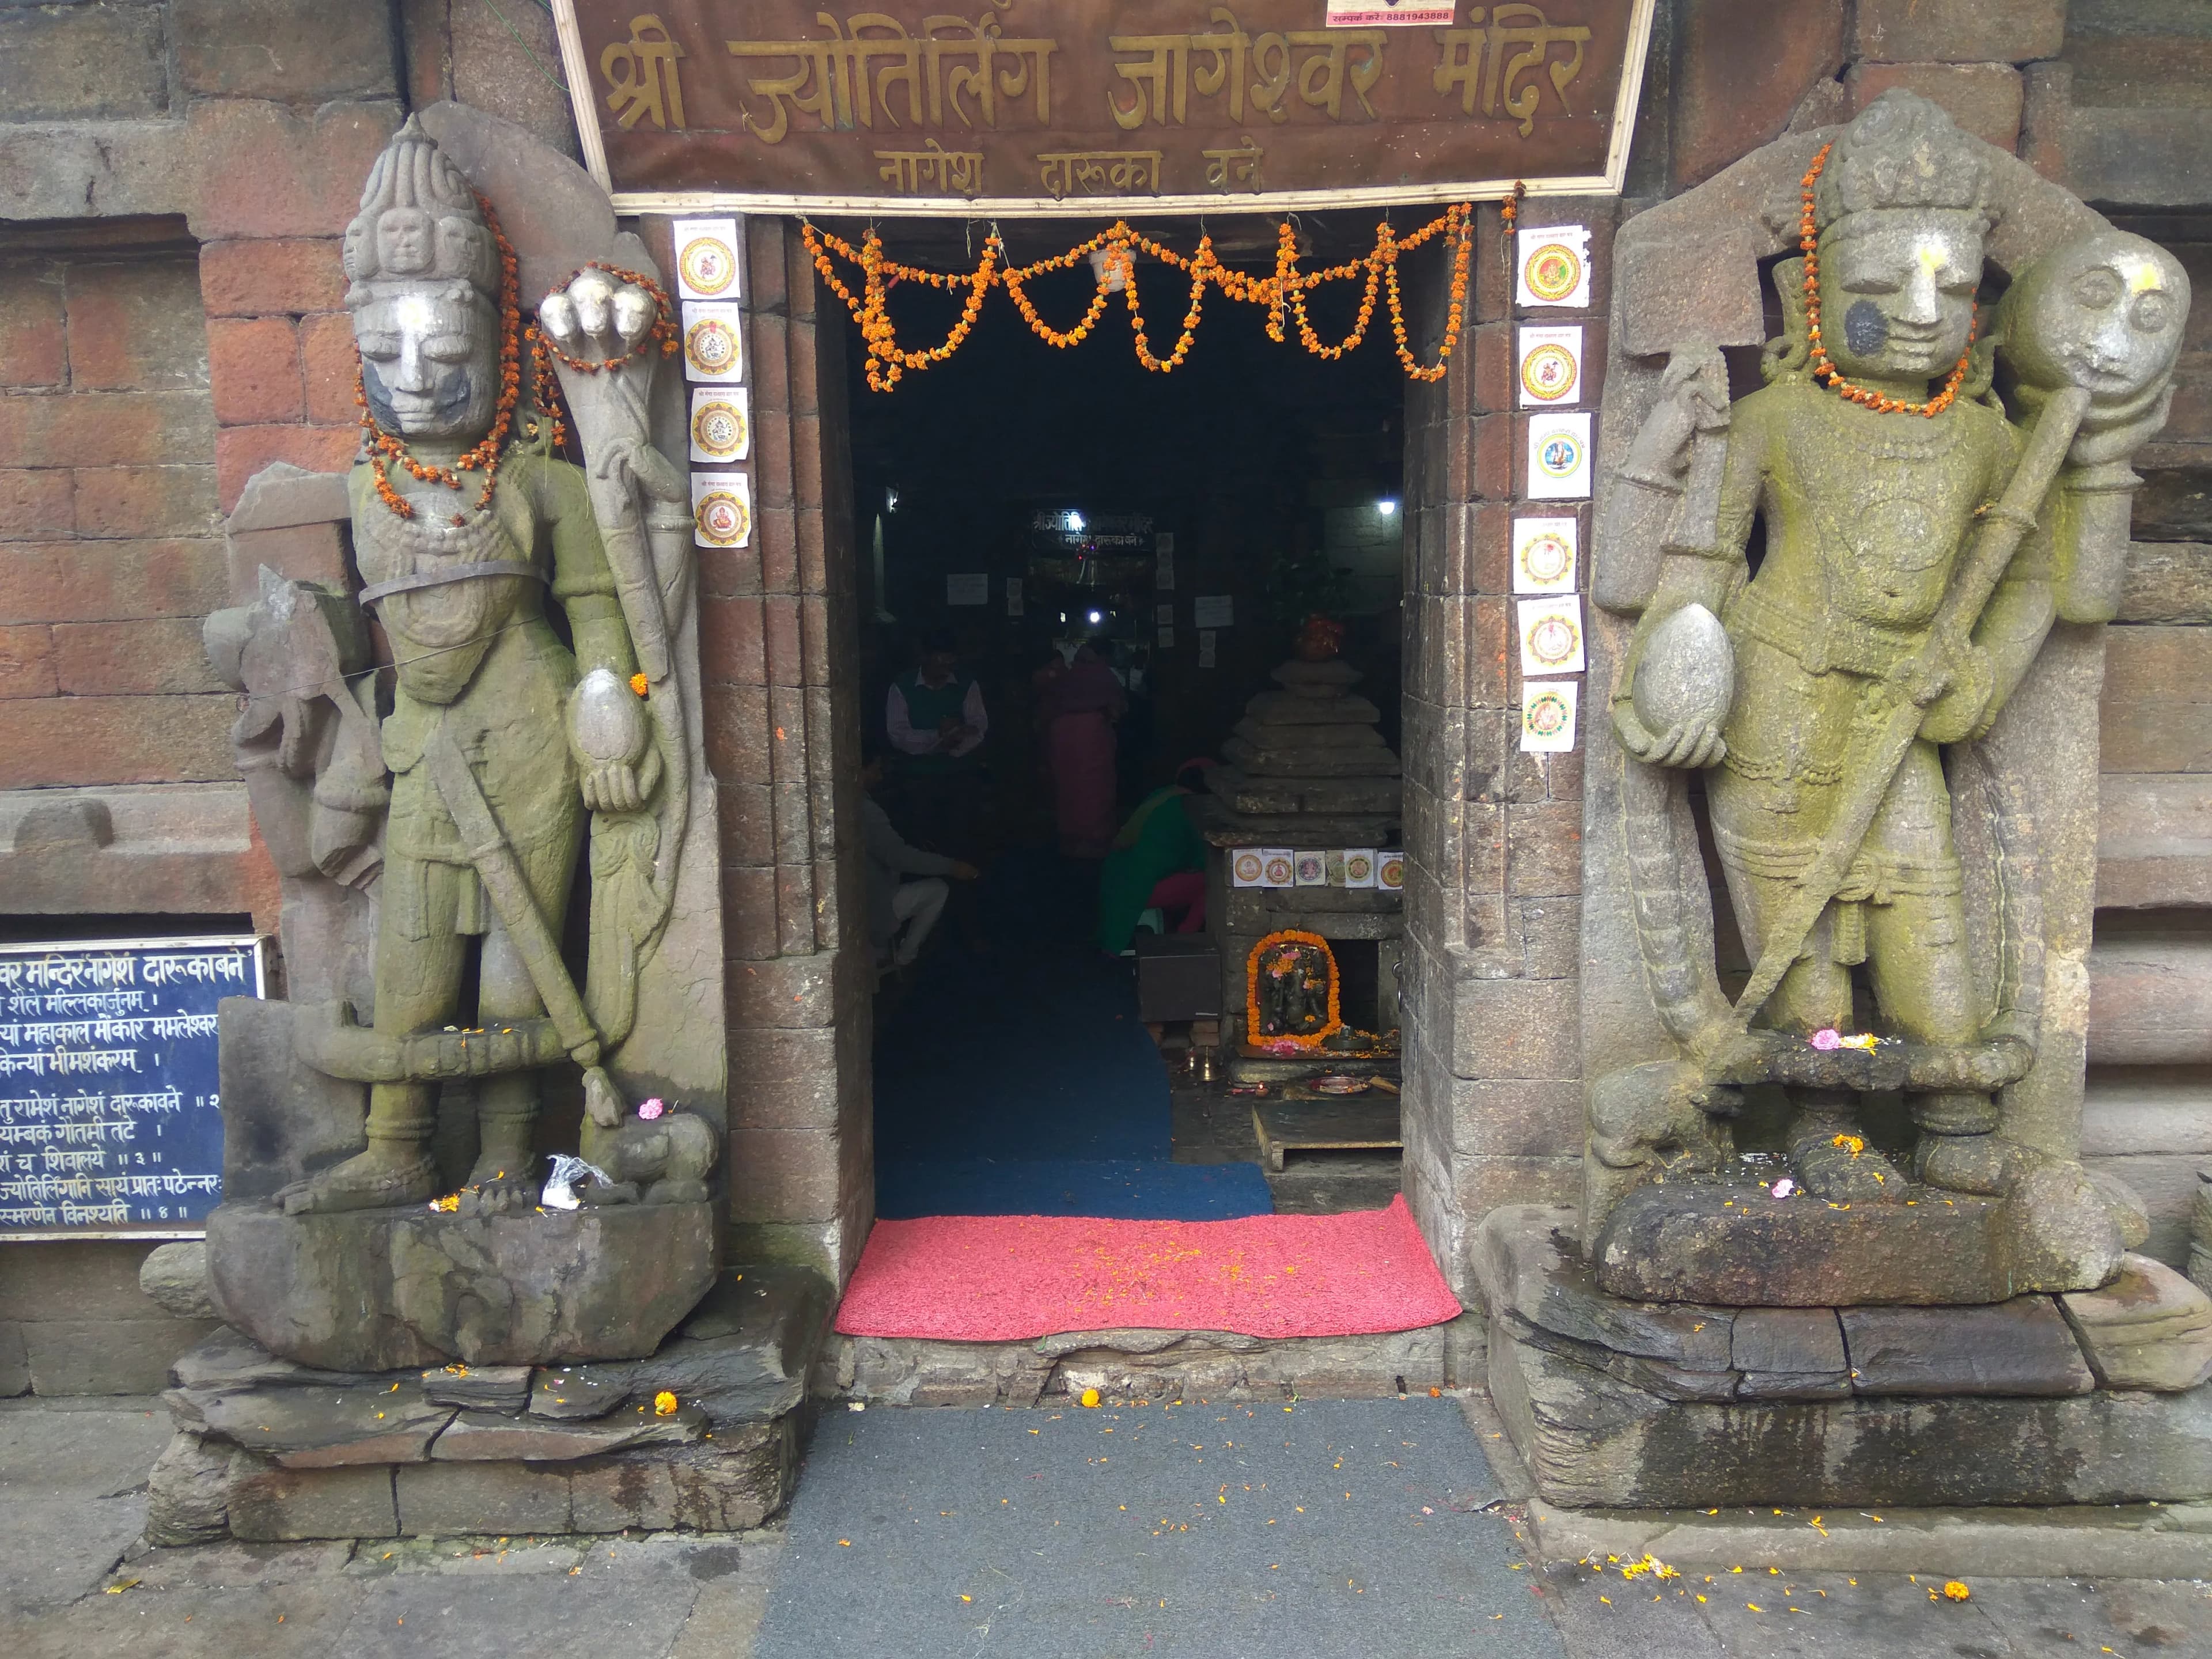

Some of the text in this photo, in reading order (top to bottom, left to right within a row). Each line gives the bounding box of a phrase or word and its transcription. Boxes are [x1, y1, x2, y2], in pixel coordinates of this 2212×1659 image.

[1386, 12, 1449, 21] 8881943888
[600, 13, 687, 131] श्री
[1107, 6, 1387, 131] जागेश्वर
[1433, 3, 1592, 138] मंदिर
[873, 138, 984, 195] नागेश
[1201, 135, 1264, 195] वने
[7, 987, 44, 1016] शैले
[13, 1089, 60, 1119] रामेशं
[60, 1088, 106, 1116] नागेशं
[15, 1153, 38, 1173] च
[40, 1143, 107, 1172] शिवालये
[134, 1152, 146, 1165] ३
[94, 1171, 130, 1197] सायं
[59, 1198, 132, 1226] विनश्यति
